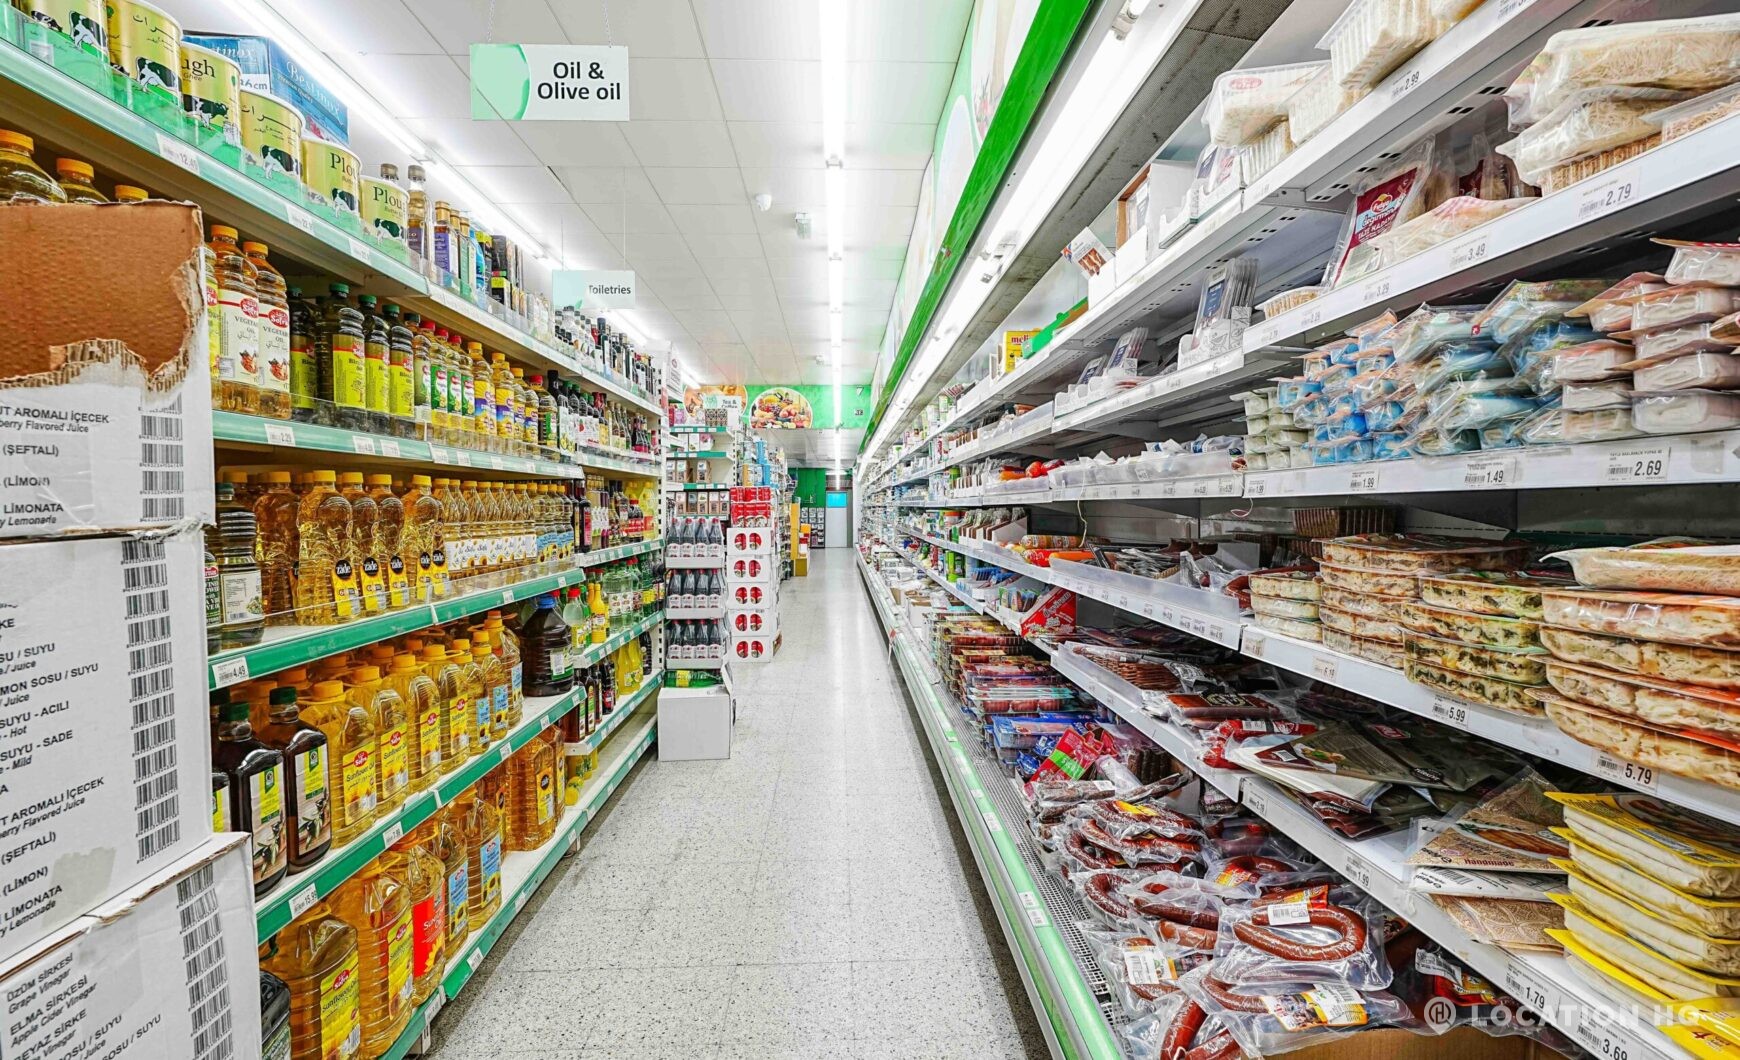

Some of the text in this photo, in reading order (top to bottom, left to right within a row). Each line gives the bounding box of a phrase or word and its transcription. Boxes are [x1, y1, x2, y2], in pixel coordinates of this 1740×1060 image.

[553, 62, 604, 79] Oil &
[1404, 72, 1420, 91] 2.99
[537, 82, 621, 100] Olive oil
[1605, 183, 1632, 207] 2.79
[589, 284, 632, 295] Toiletries
[14, 406, 68, 421] AROMALI
[70, 410, 110, 424] İÇECEK
[25, 420, 64, 432] Flavored
[66, 423, 89, 433] Juice
[3, 444, 59, 457] (ŞEFTALİ)
[1487, 470, 1504, 483] 1.49
[1634, 460, 1662, 477] 2.69
[1363, 477, 1375, 488] 1.99
[4, 502, 64, 514] LİMONATA
[23, 643, 55, 658] SUYU
[11, 660, 37, 673] Juice
[31, 671, 62, 688] SOSU
[70, 663, 99, 678] SUYU
[4, 692, 30, 708] Juice
[40, 700, 70, 718] ACILI
[1448, 706, 1466, 723] 5.99
[10, 725, 27, 739] Hot
[43, 730, 74, 748] SADE
[12, 755, 33, 770] Mild
[1625, 763, 1652, 785] 5.79
[11, 793, 64, 823] AROMALI
[66, 776, 105, 799] İÇECEK
[22, 806, 62, 830] Flavored
[63, 797, 86, 812] Juice
[1, 831, 57, 866] (ŞEFTALİ)
[1464, 858, 1515, 867] Handmade
[3, 866, 49, 897] (LİMON)
[1357, 871, 1370, 887] 1.99
[4, 884, 63, 921] LİMONATA
[9, 900, 57, 931] Lemonade
[6, 952, 74, 1003] ÜZÜM SİRKESİ
[8, 968, 71, 1015] Grape Vinegar
[1525, 986, 1546, 1009] 1.79
[10, 974, 88, 1036] ELMA SİRKESİ
[10, 1022, 39, 1048] Apple
[66, 982, 98, 1010] Vinegar
[54, 1008, 88, 1037] SİRKE
[94, 1014, 123, 1040] SUYU
[136, 1013, 162, 1039] SUYU
[1602, 1038, 1628, 1060] 3.69
